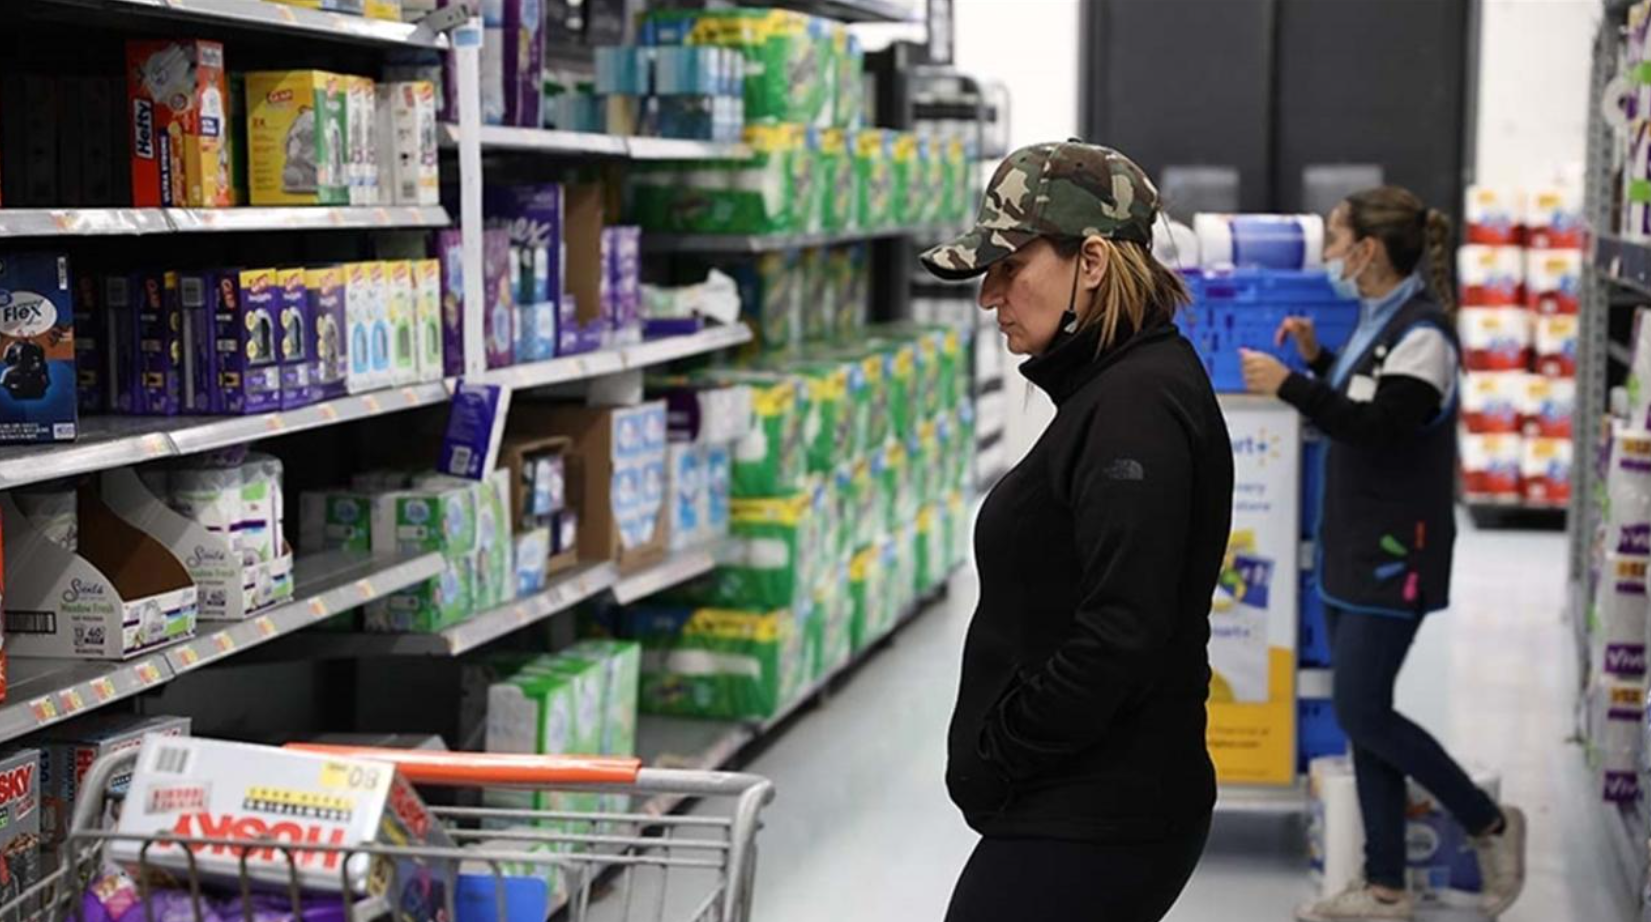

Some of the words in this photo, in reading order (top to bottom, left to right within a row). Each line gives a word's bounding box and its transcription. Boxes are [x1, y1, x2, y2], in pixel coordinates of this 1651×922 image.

[137, 102, 151, 154] Hefty
[4, 300, 44, 325] Flex
[159, 812, 344, 869] HUSKY
